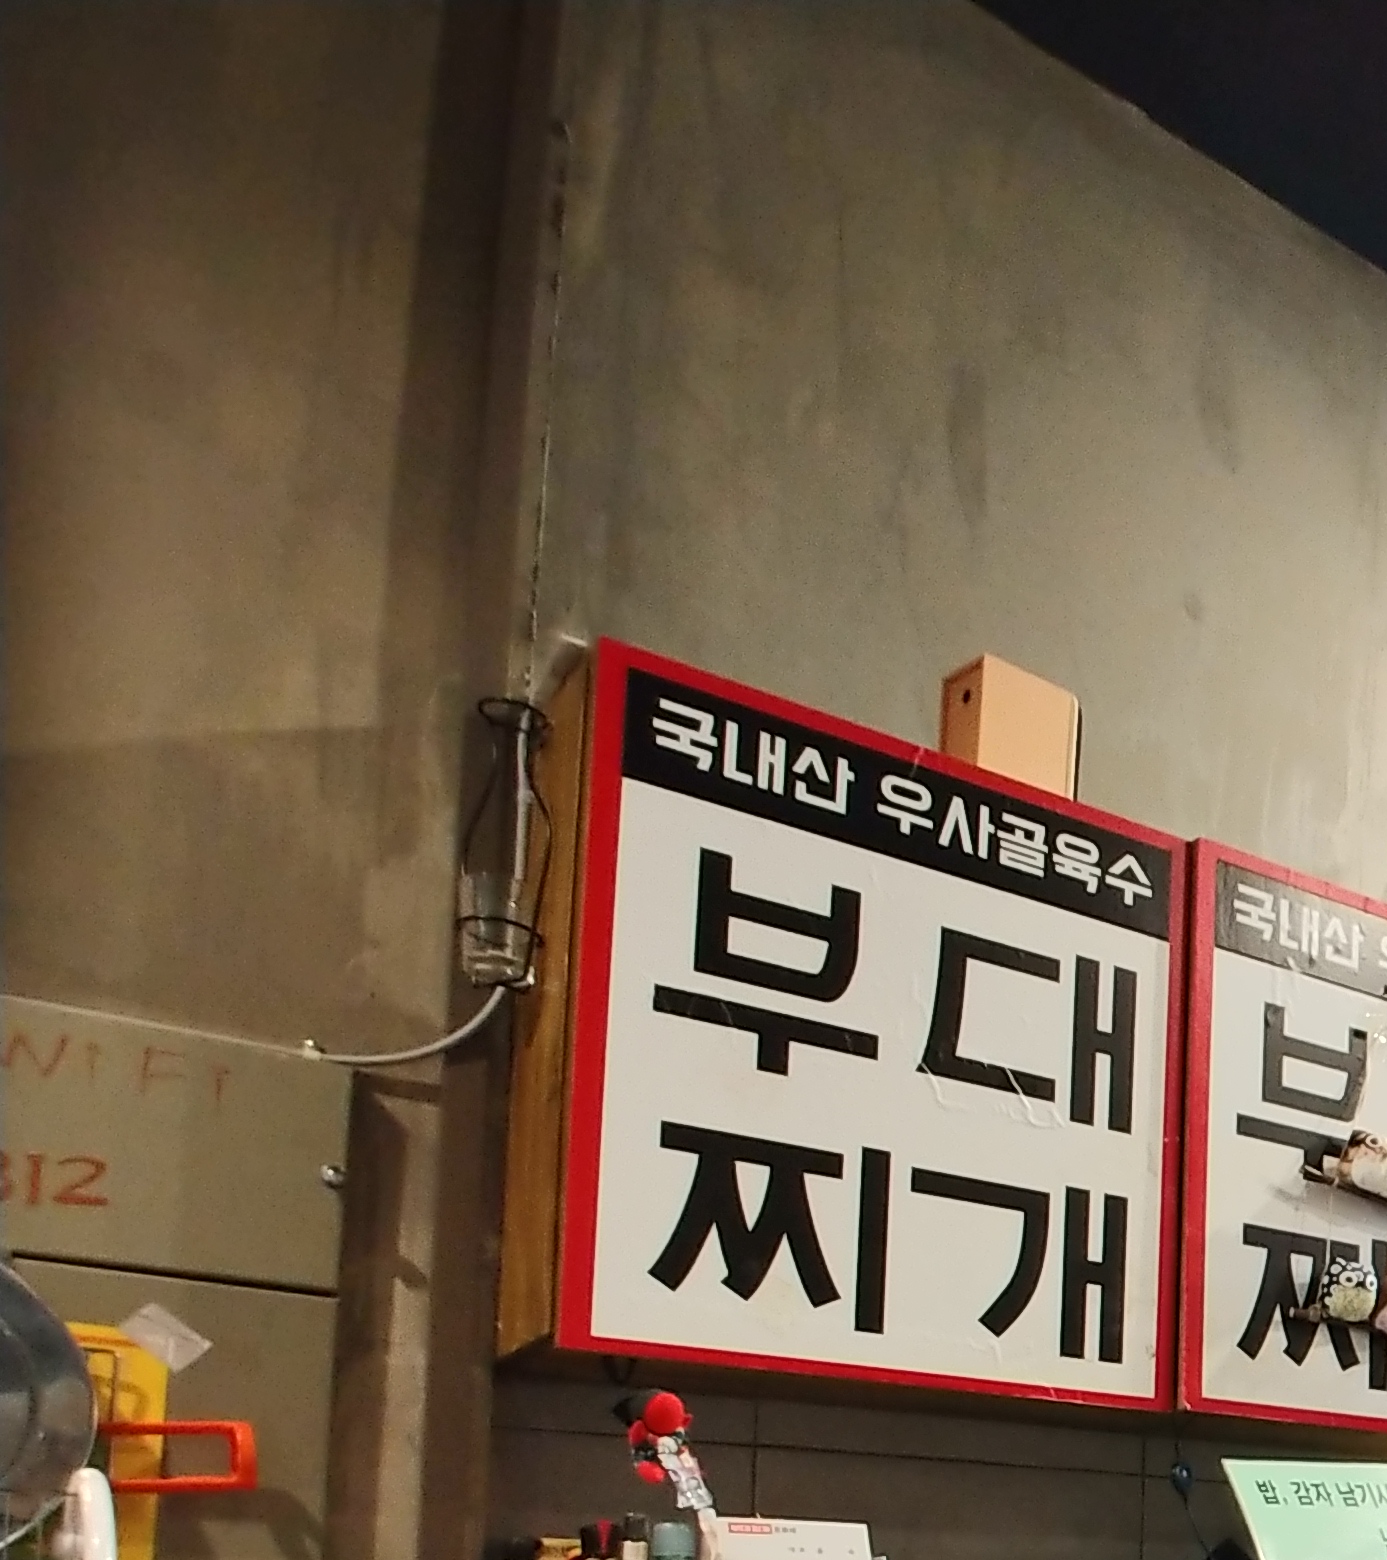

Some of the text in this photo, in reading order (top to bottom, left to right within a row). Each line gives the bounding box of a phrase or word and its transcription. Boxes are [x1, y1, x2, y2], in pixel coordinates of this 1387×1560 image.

[652, 697, 1153, 907] 국내산 우사골육수
[652, 846, 1138, 1128] 부대
[1233, 883, 1365, 972] 국내산
[647, 1119, 1130, 1364] 찌개
[1255, 1478, 1290, 1507] 밥,
[1289, 1479, 1335, 1508] 감자
